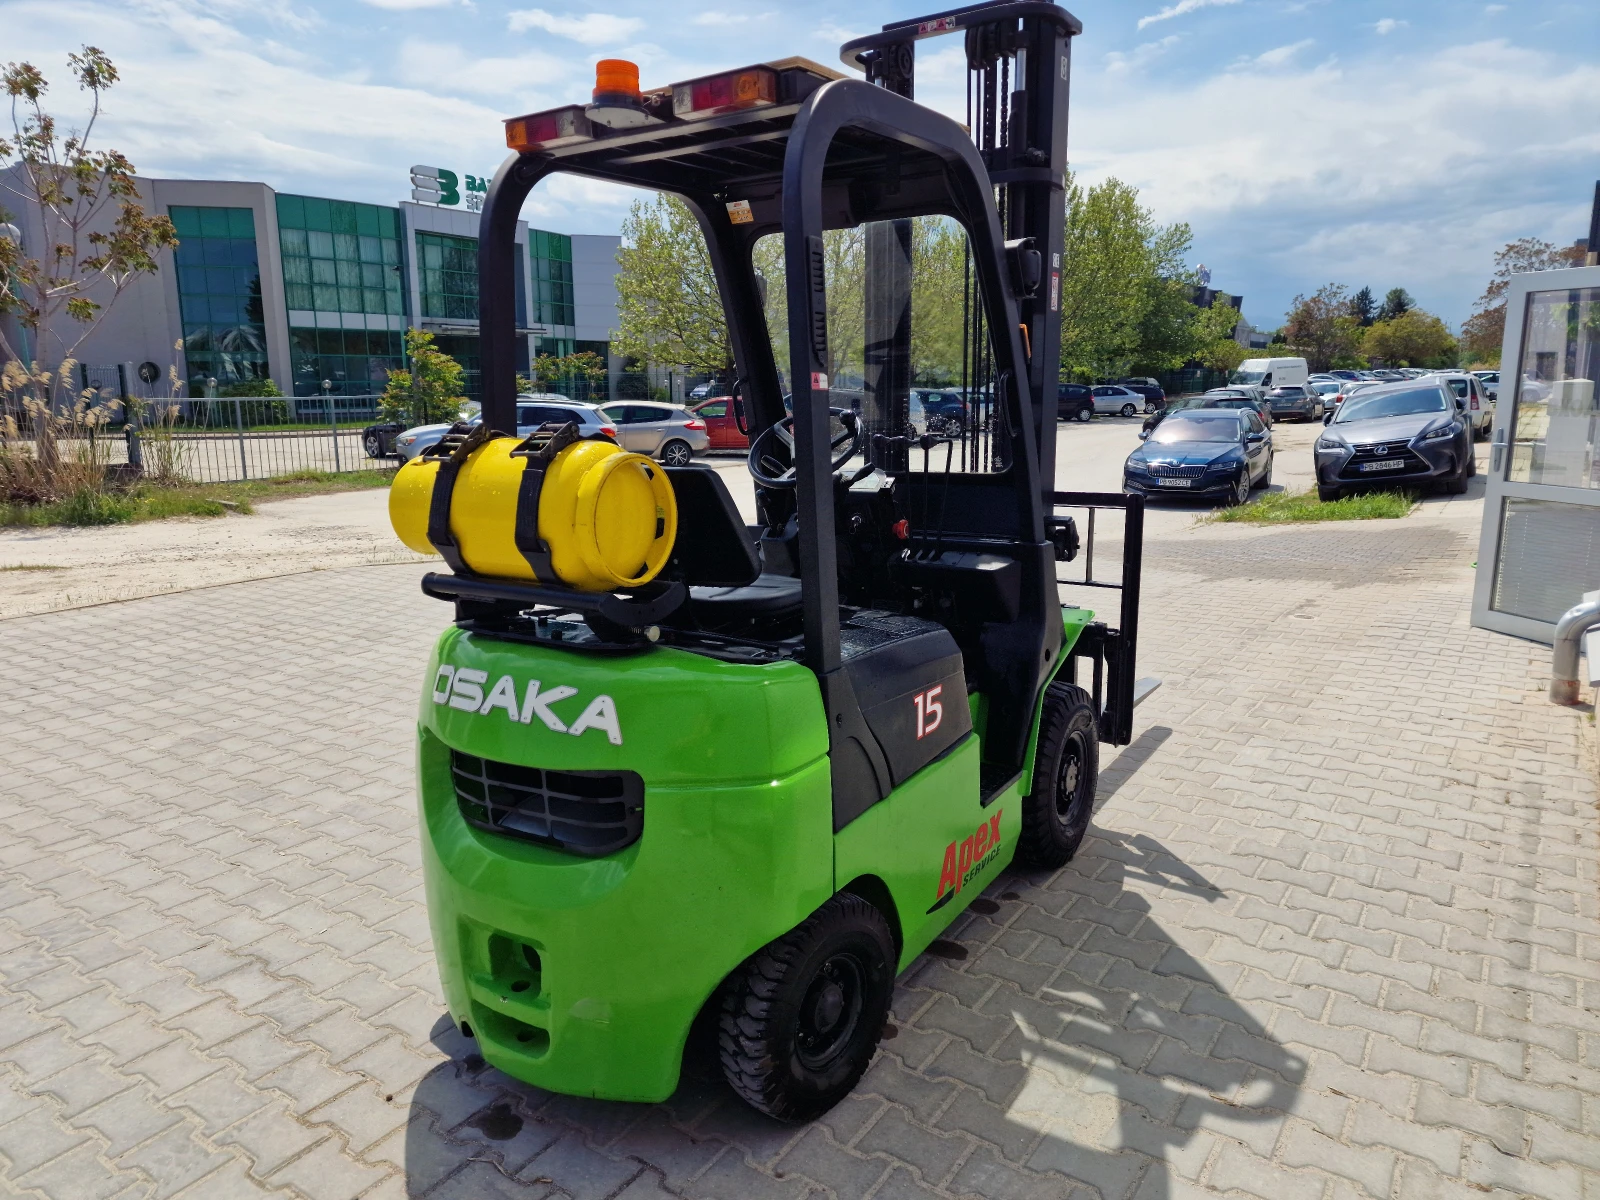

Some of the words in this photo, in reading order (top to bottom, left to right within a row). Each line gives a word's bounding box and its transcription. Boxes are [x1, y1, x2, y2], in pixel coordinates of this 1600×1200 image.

[432, 663, 624, 747] OSAKA
[913, 683, 943, 741] 15
[936, 807, 1003, 901] Apex
[962, 844, 1002, 888] SERVICE
